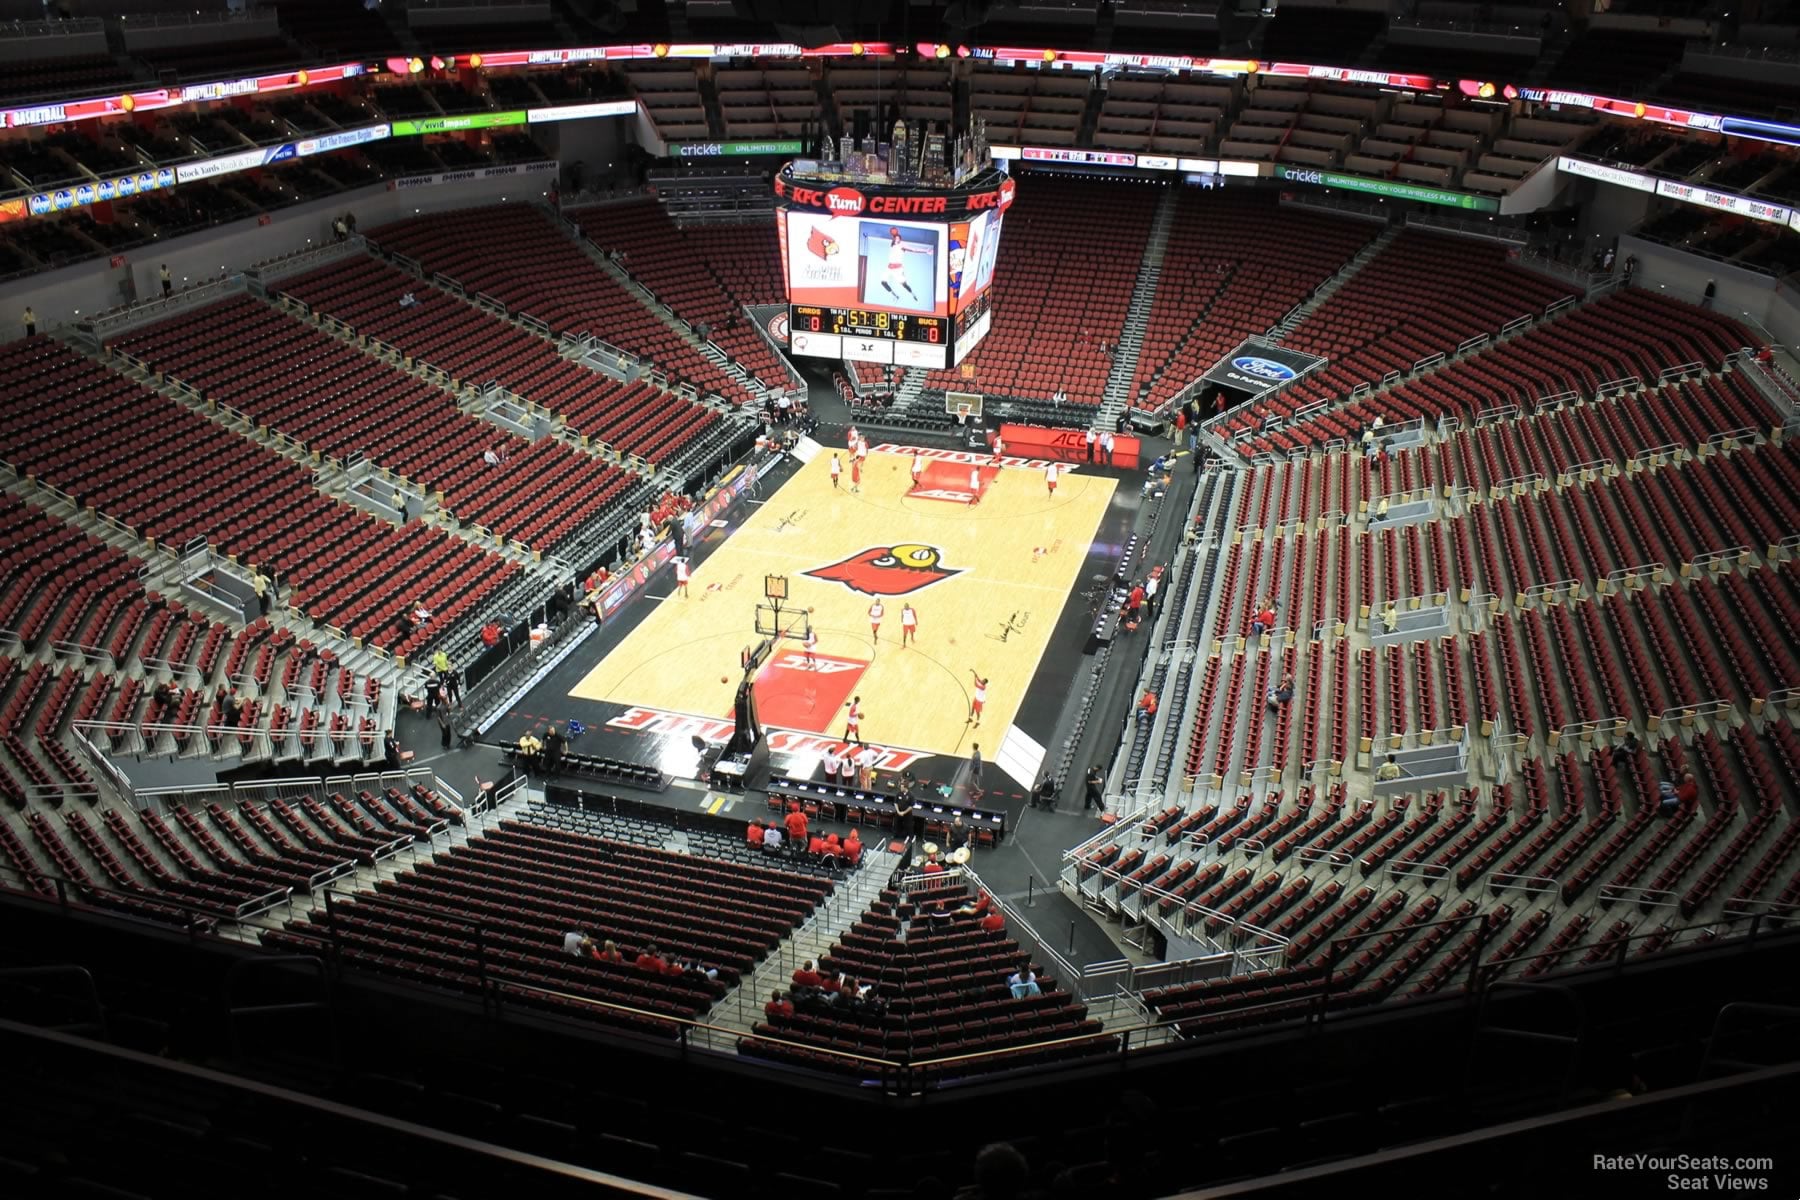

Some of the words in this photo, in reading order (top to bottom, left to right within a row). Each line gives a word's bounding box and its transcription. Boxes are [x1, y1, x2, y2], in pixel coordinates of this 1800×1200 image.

[680, 142, 722, 157] cricket
[735, 144, 776, 153] UNLIMITED
[777, 144, 797, 153] TALK
[179, 167, 199, 179] Stock
[199, 163, 220, 175] Yards
[220, 159, 237, 171] Bank
[1284, 168, 1323, 185] cricket
[1327, 176, 1358, 187] UNLIMITED
[1358, 181, 1378, 191] MUSIC
[1378, 184, 1388, 192] ON
[1389, 186, 1407, 195] YOUR
[1407, 188, 1439, 201] WIRELESS
[1439, 194, 1457, 203] PLAN
[792, 189, 825, 207] KFC
[827, 192, 863, 212] Yum!
[869, 196, 947, 214] CENTER
[966, 192, 998, 211] KFC
[798, 307, 822, 316] CARDS
[850, 310, 888, 328] 57:18
[811, 316, 820, 331] 0
[837, 315, 844, 325] 0
[898, 320, 905, 330] 0
[929, 327, 939, 343] 0
[1227, 372, 1241, 380] Go
[1242, 360, 1285, 379] Ford
[1051, 432, 1087, 448] ACC
[909, 488, 977, 502] ACC
[773, 654, 866, 675] ACC
